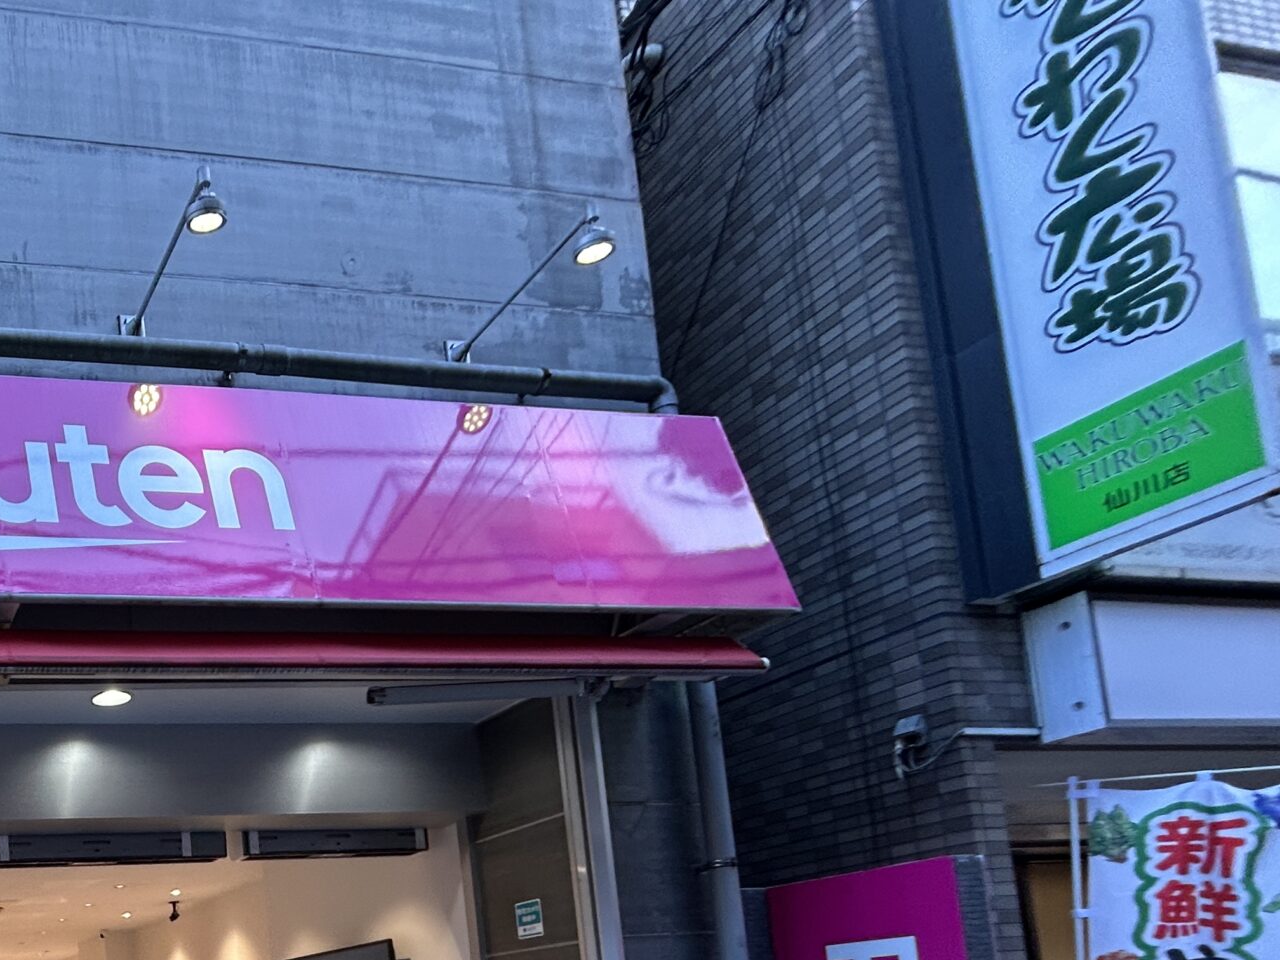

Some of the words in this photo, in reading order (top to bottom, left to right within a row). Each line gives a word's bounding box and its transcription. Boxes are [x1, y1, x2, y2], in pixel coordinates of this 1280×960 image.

[1076, 417, 1210, 491] HIROBA
[1103, 461, 1190, 513] 仙川店
